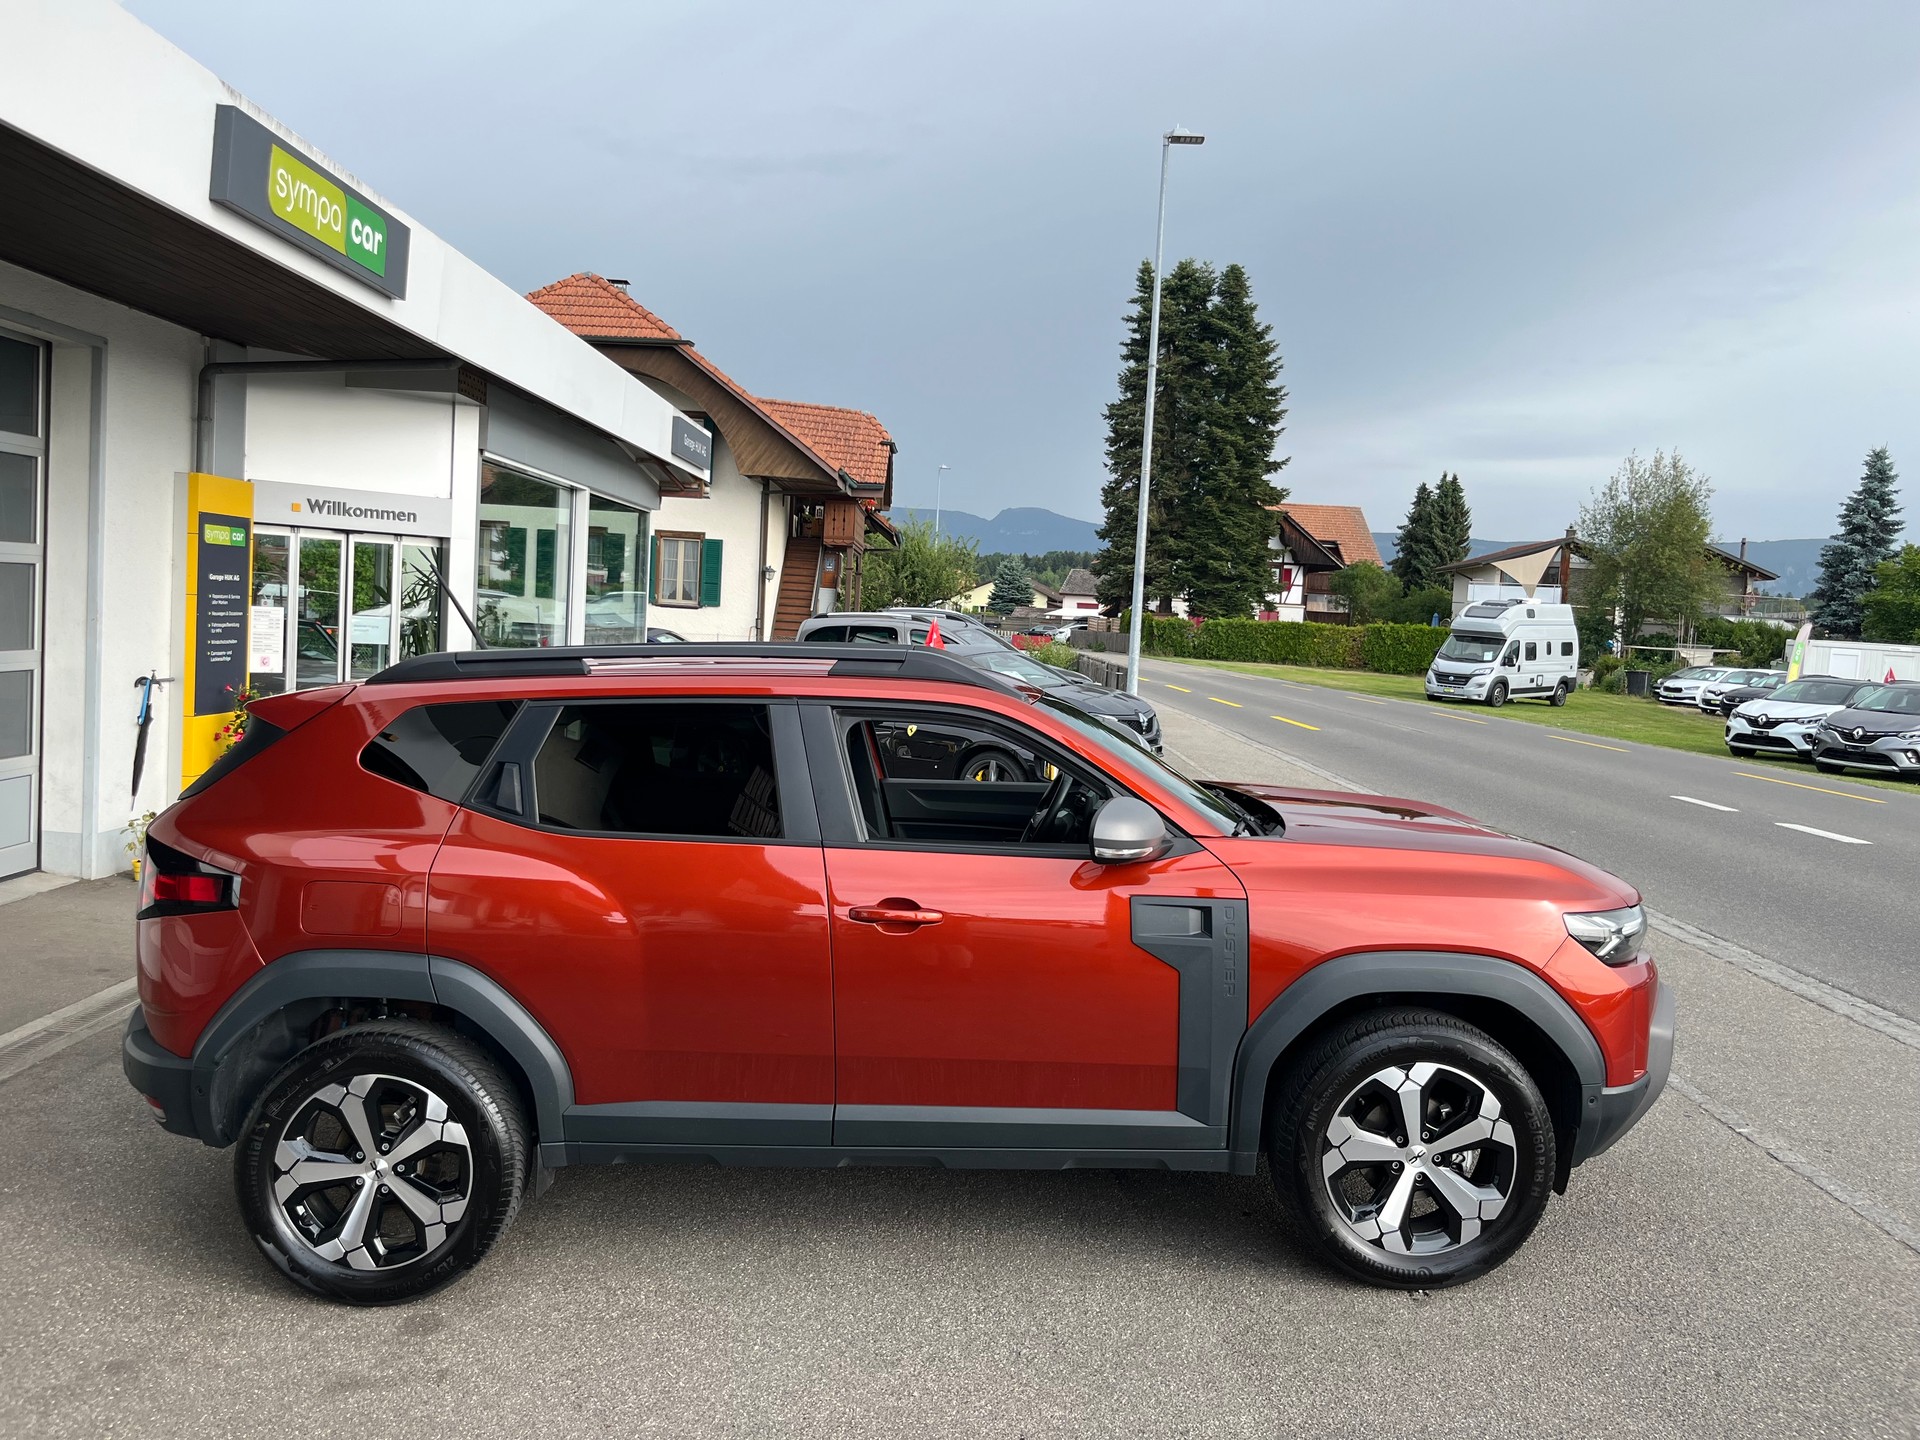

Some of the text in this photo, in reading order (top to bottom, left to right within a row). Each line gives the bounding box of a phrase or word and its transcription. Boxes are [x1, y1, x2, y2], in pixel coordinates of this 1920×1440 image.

[276, 168, 383, 255] sympa car
[306, 498, 418, 523] Willkommen
[206, 529, 244, 543] sympa car
[1223, 906, 1236, 997] DUSTER
[1523, 1106, 1546, 1153] 215/60
[1533, 1168, 1545, 1182] 18
[1530, 1185, 1541, 1197] H
